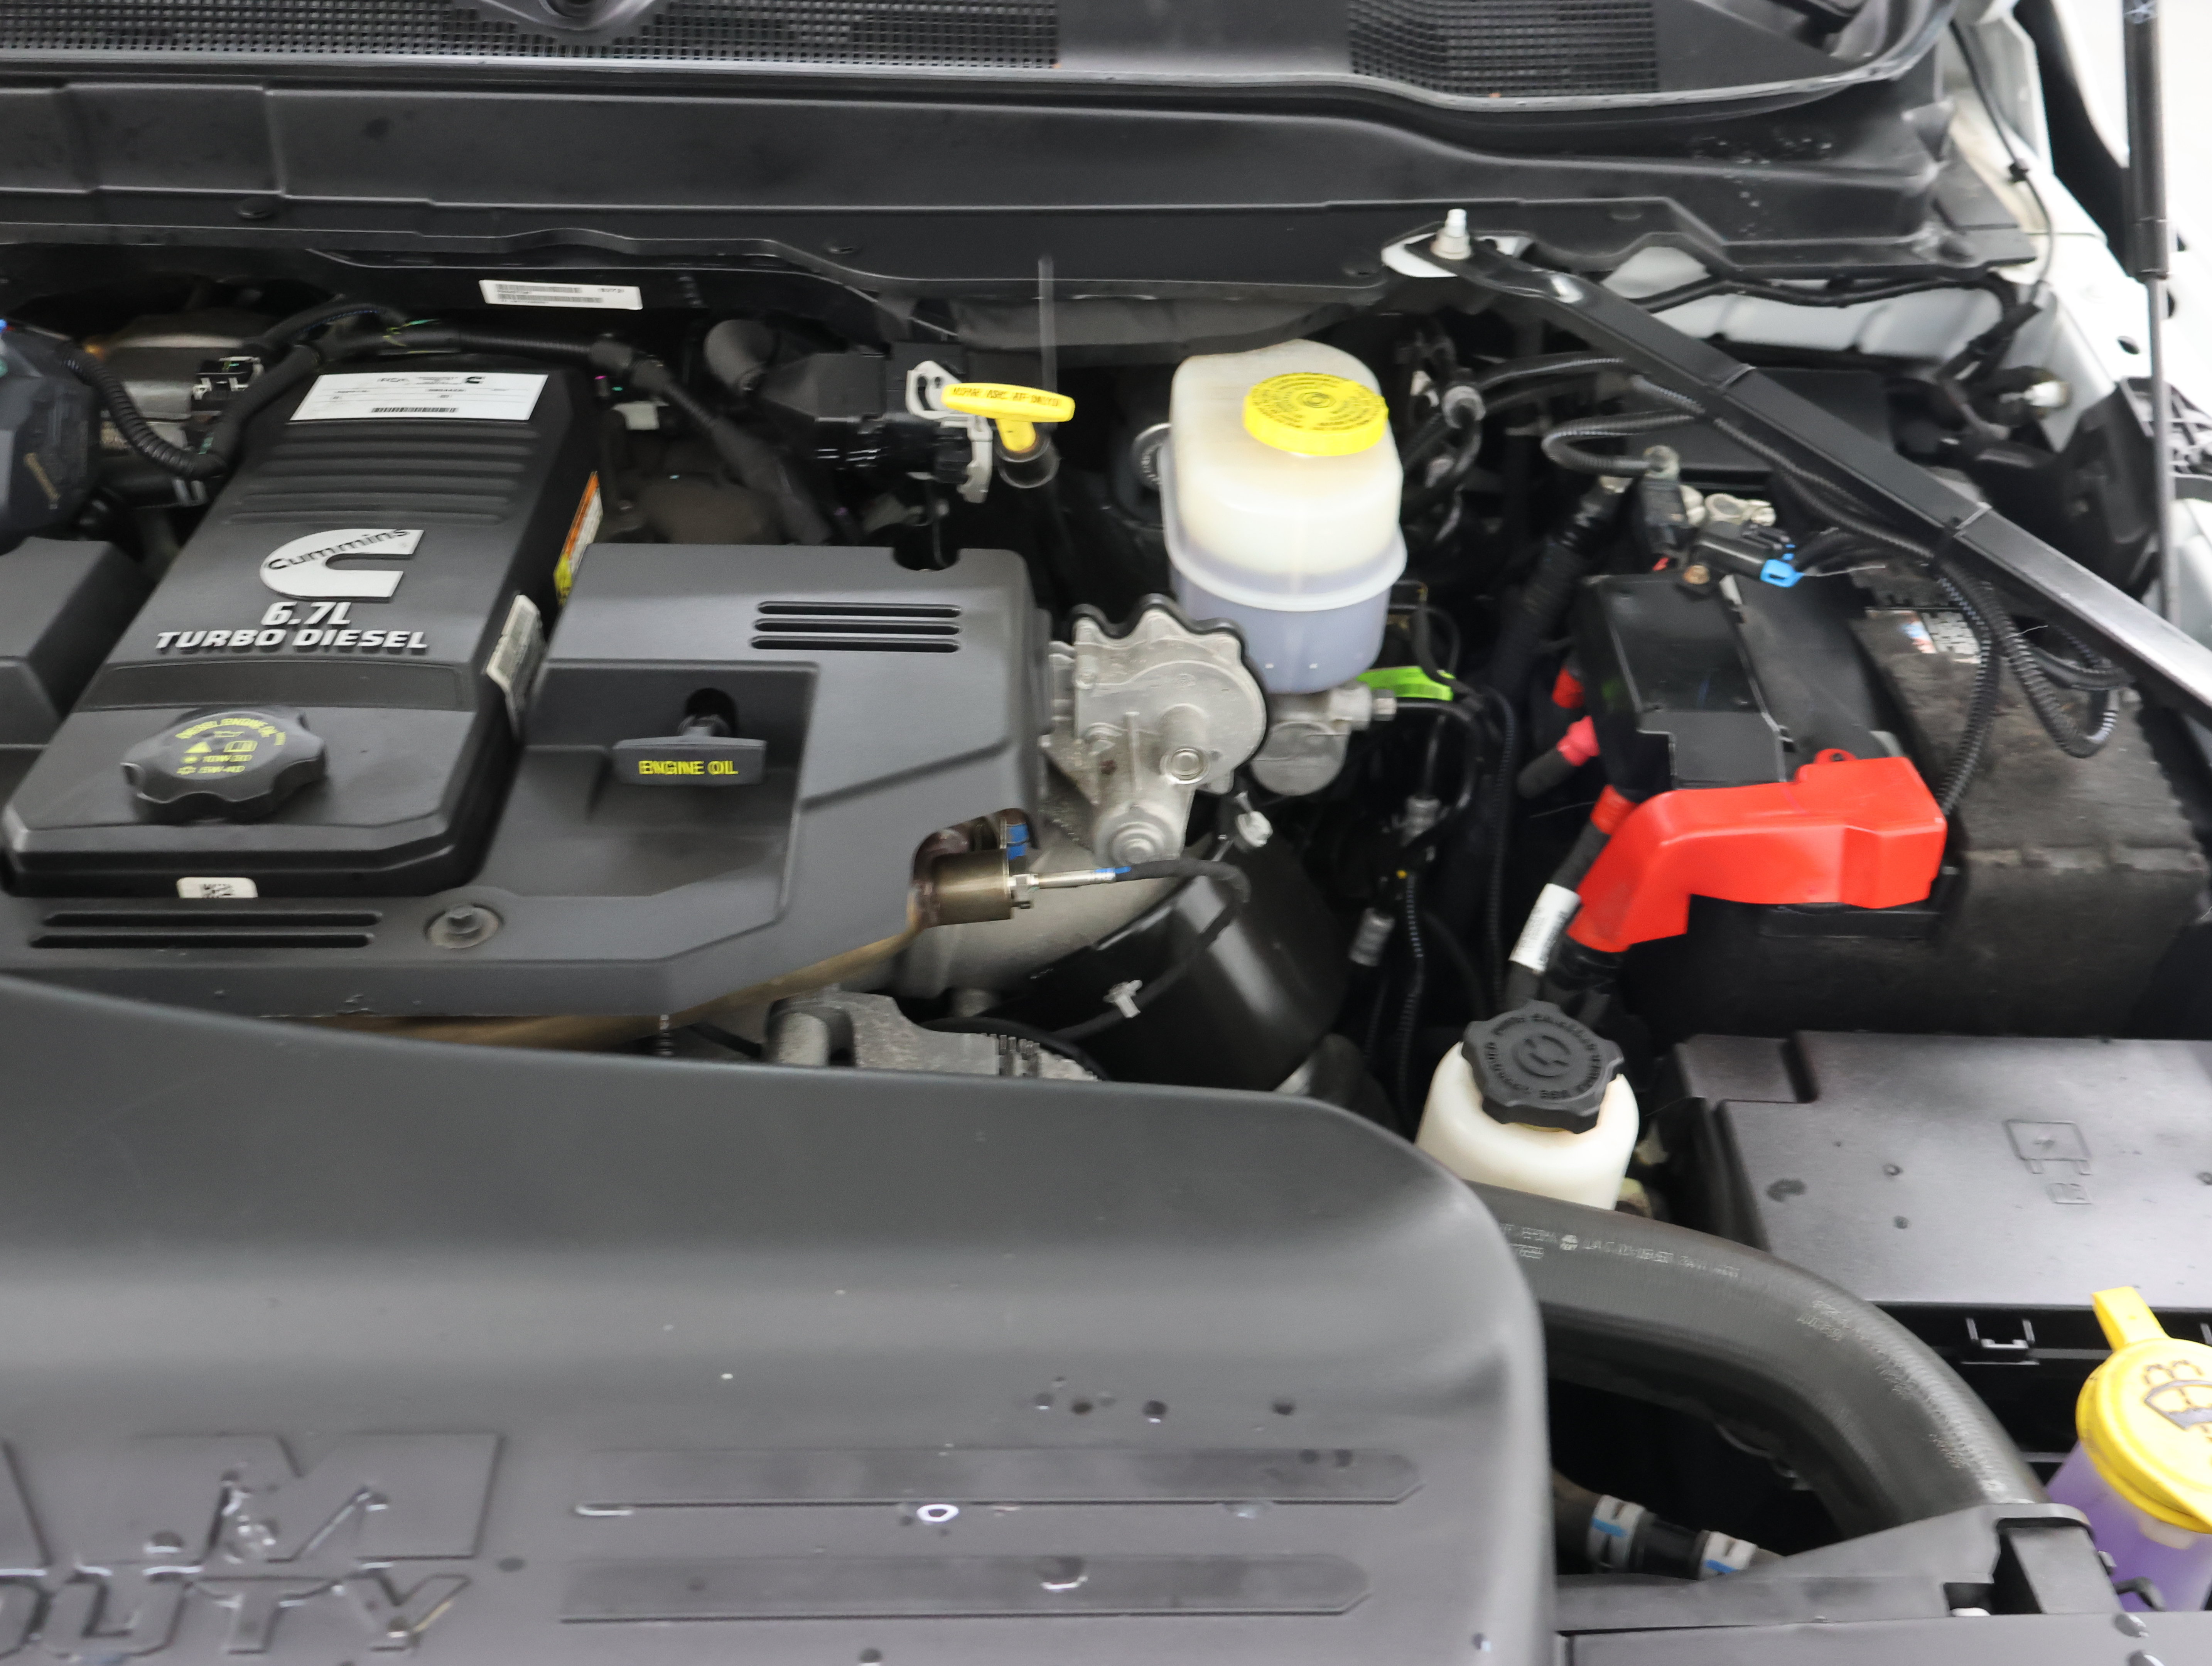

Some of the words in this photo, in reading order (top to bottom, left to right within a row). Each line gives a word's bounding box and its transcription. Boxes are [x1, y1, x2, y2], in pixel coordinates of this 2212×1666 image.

[268, 528, 412, 570] Cummins
[261, 602, 352, 626] 6.7L
[155, 629, 287, 649] TURBO
[292, 629, 428, 649] DIESEL
[638, 760, 705, 775] ENGINE
[707, 760, 739, 775] OIL
